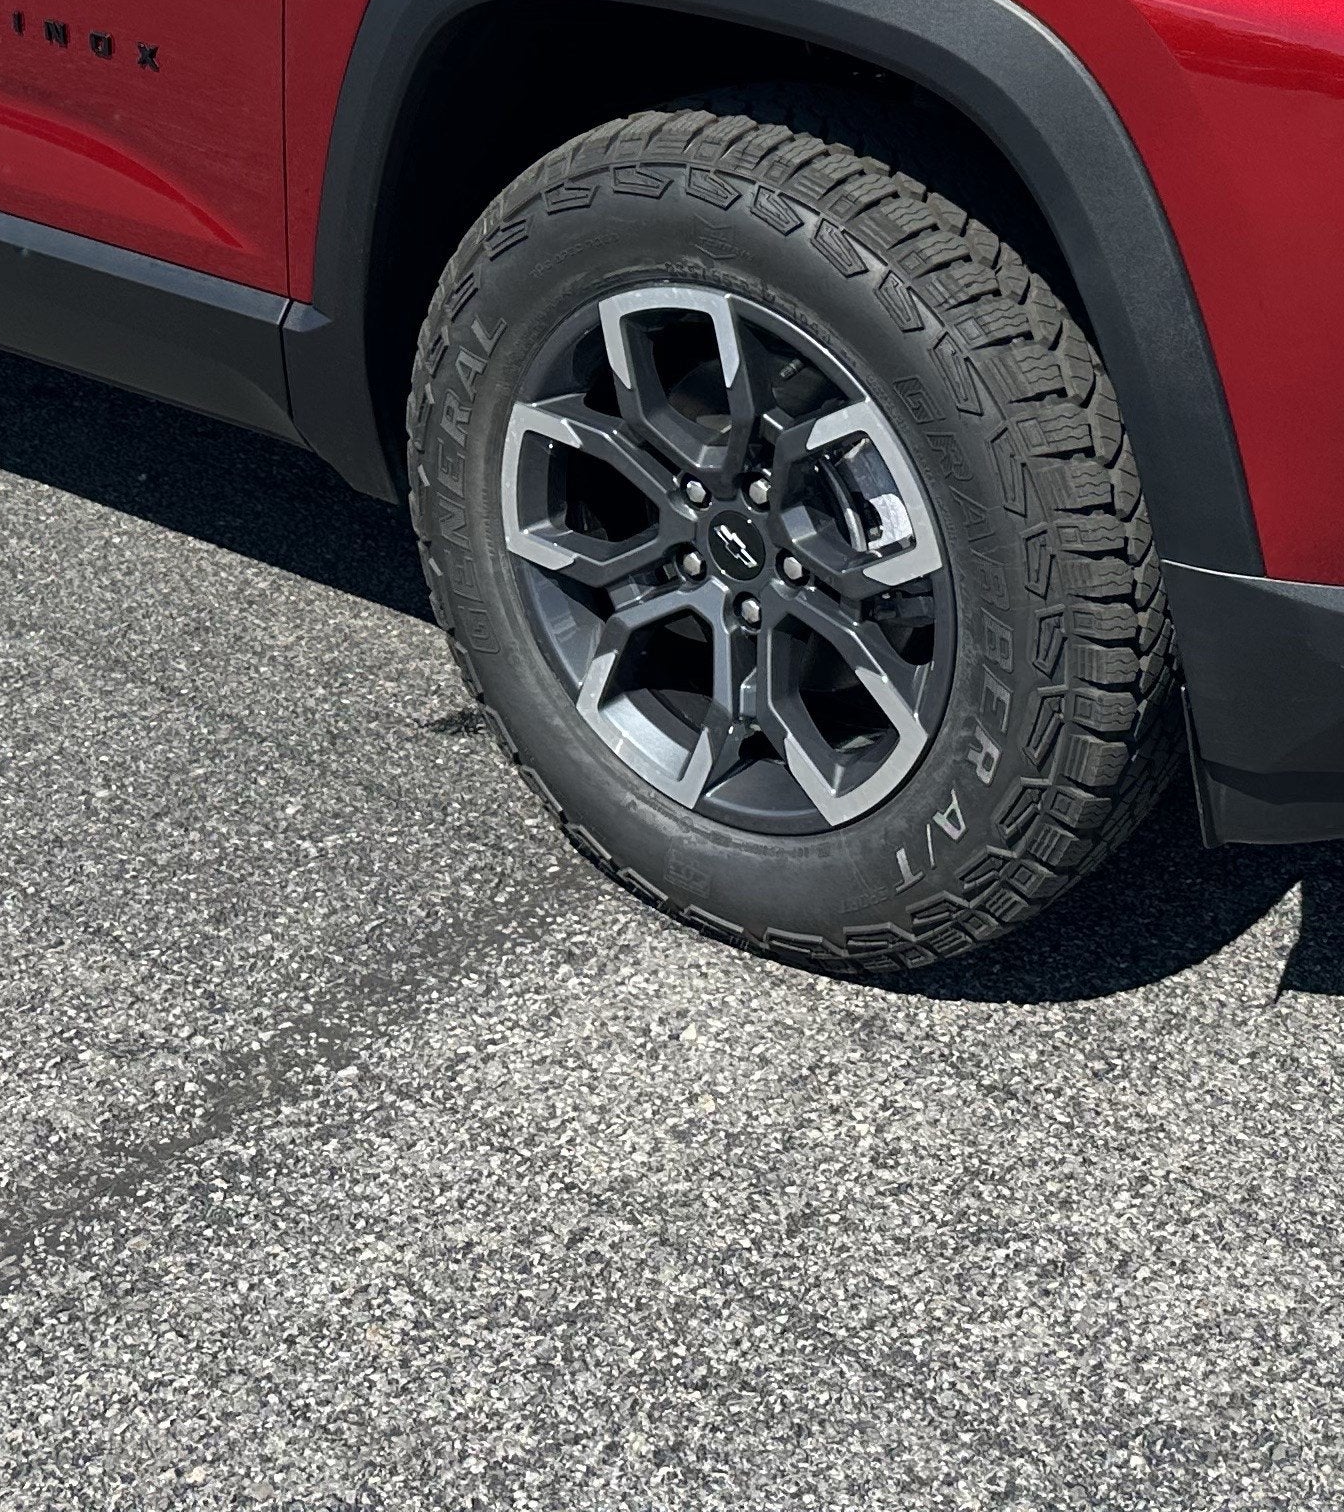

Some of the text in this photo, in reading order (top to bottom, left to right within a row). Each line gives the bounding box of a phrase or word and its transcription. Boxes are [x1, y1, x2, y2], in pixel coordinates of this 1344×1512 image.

[434, 314, 508, 657] GENERAL
[894, 374, 1015, 786] GRABBER
[894, 788, 968, 894] A/T
